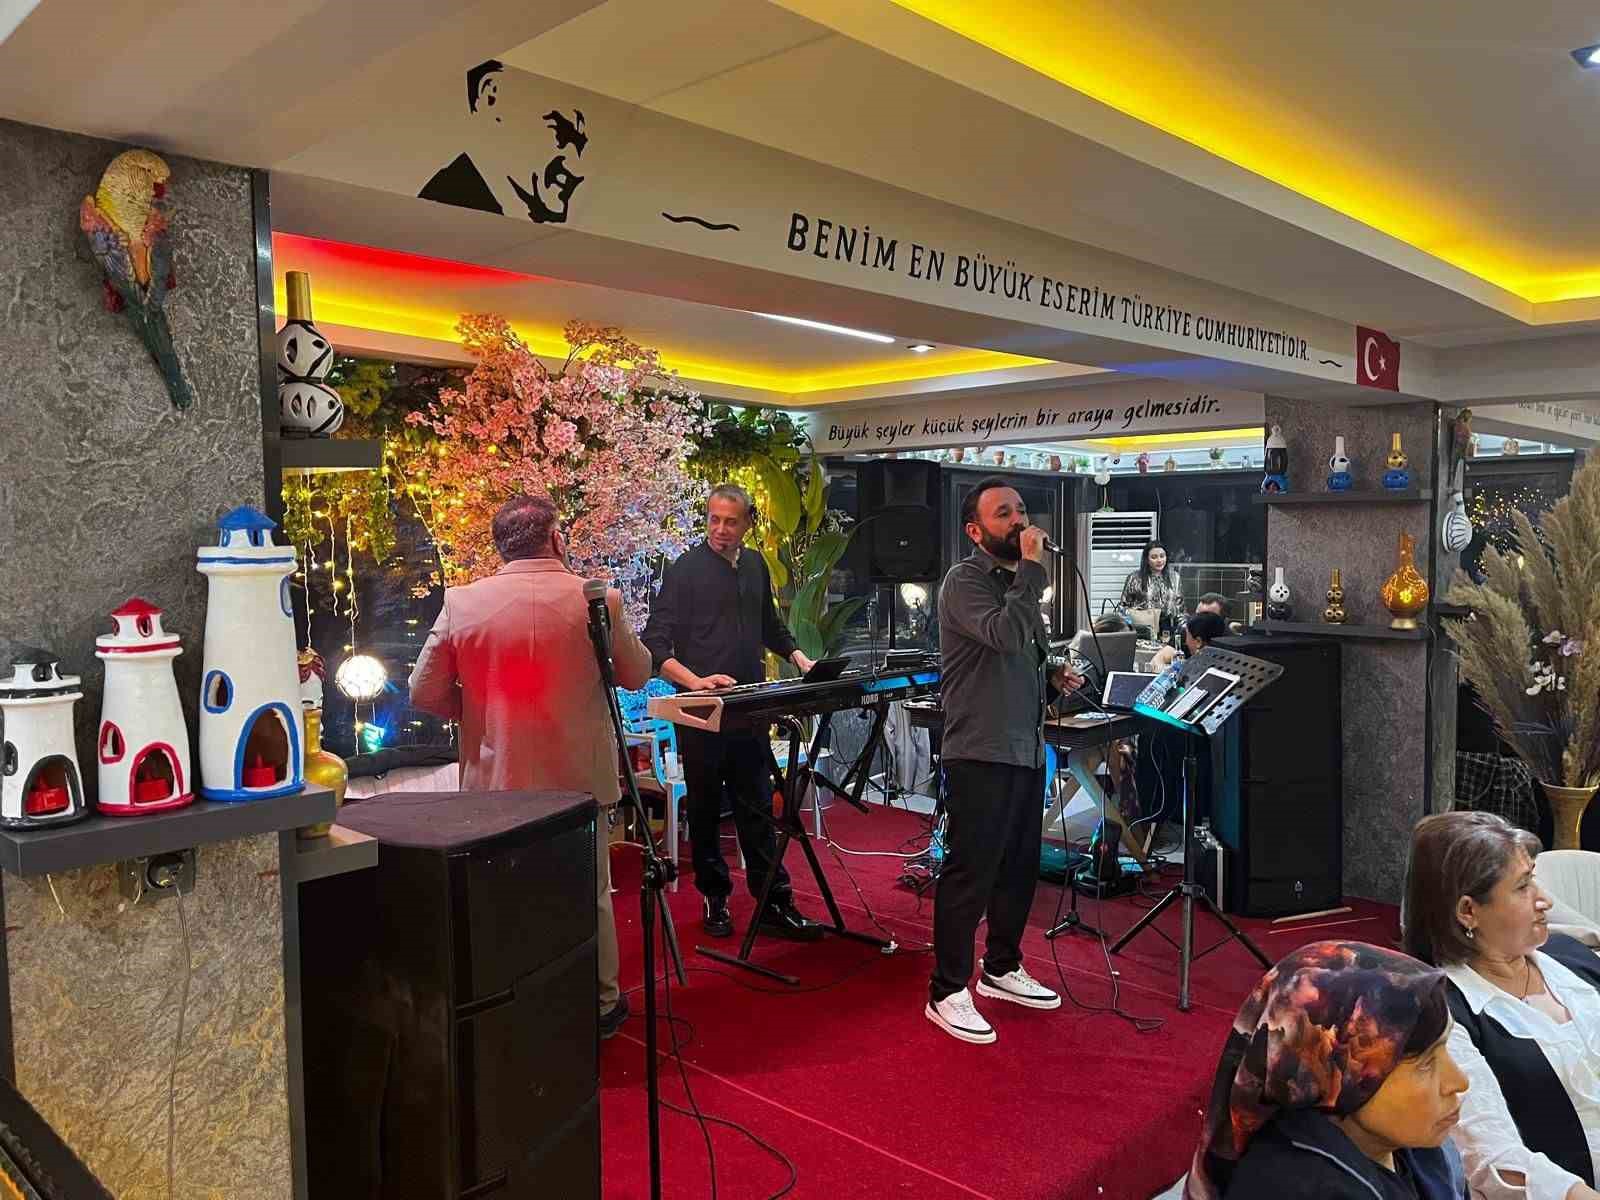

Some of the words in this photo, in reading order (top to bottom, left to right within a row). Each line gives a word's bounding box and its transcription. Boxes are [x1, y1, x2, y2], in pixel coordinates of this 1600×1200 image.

[788, 213, 898, 271] BENİM
[908, 244, 945, 281] EN
[954, 253, 1035, 301] BÜYÜK
[1040, 276, 1116, 320] ESERİM
[1121, 294, 1192, 336] TÜRKİYE
[828, 422, 868, 448] Büyük
[876, 421, 916, 445] şeyler
[922, 414, 964, 436] küçük
[972, 412, 1028, 439] şeylerin
[1036, 408, 1061, 426] bir
[1067, 408, 1114, 431] araya
[1121, 395, 1221, 429] gelmesidir.
